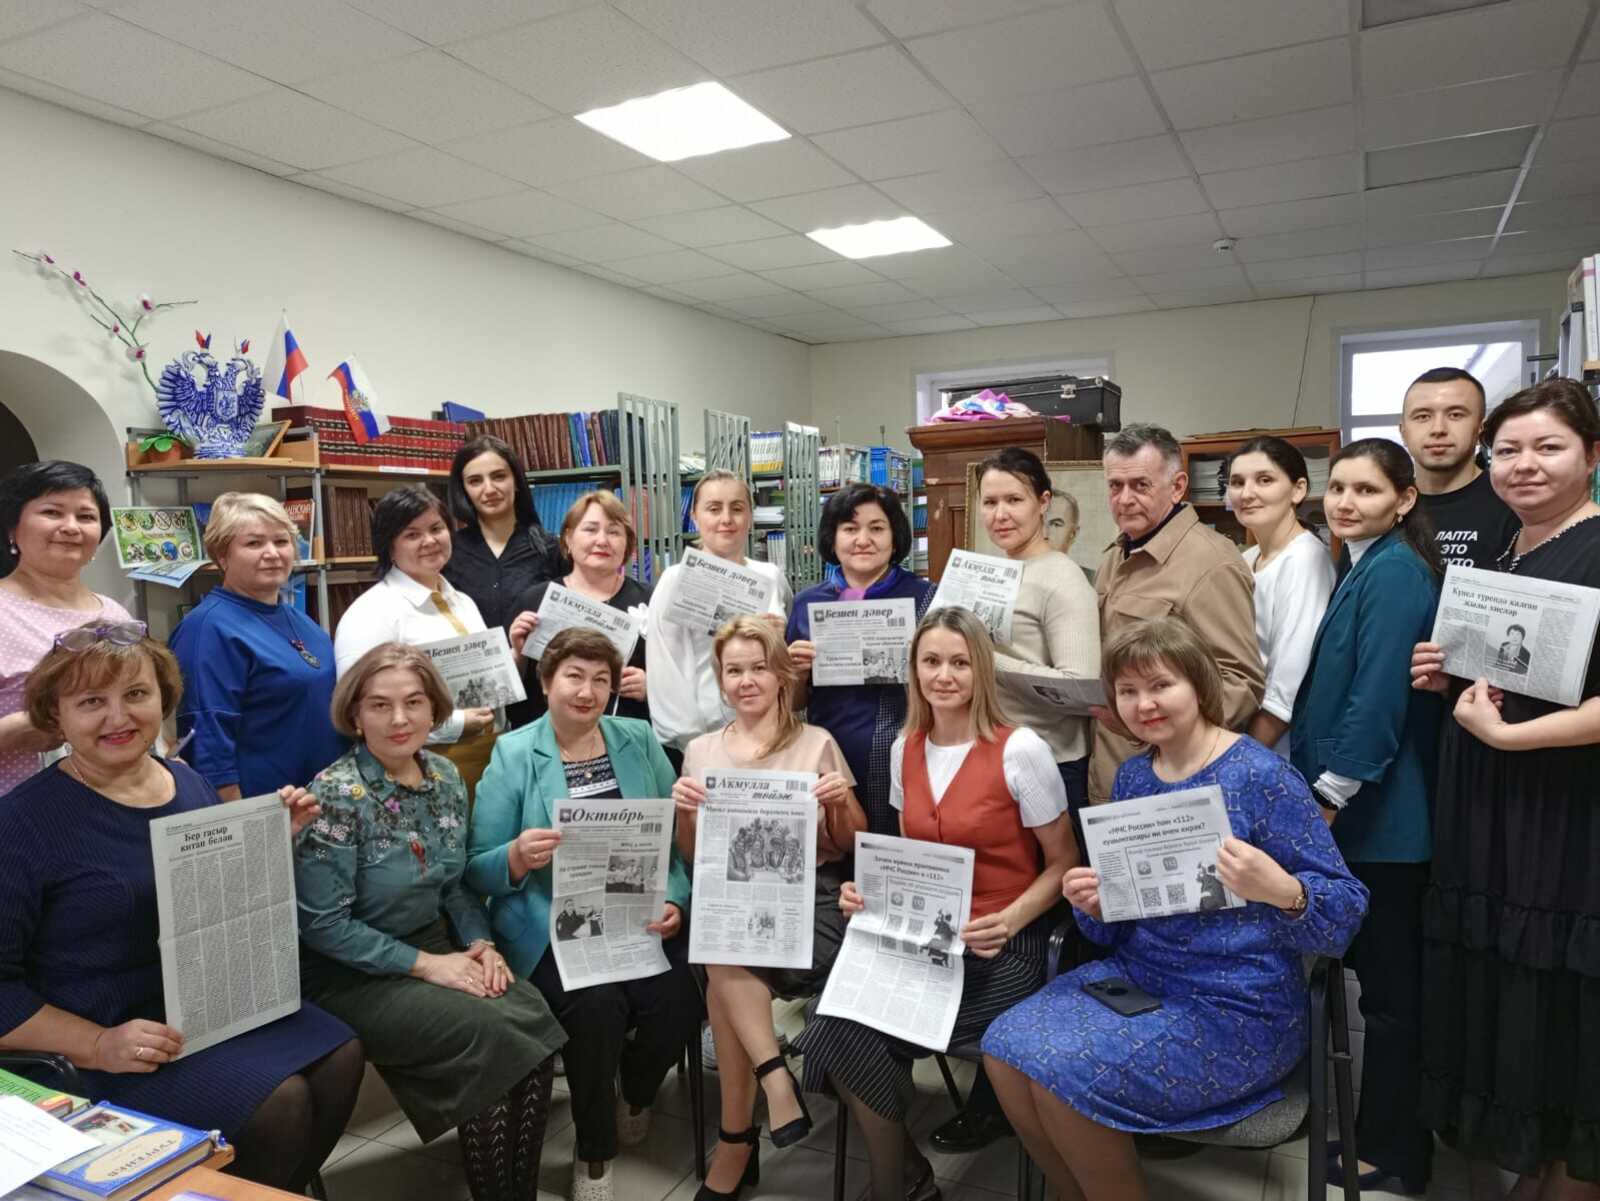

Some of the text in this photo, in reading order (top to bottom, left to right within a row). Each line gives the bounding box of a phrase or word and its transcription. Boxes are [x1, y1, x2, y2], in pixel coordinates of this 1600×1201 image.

[1434, 530, 1478, 541] ЛАПТА
[1440, 543, 1468, 554] ЭТО
[572, 808, 644, 824] Октябрь
